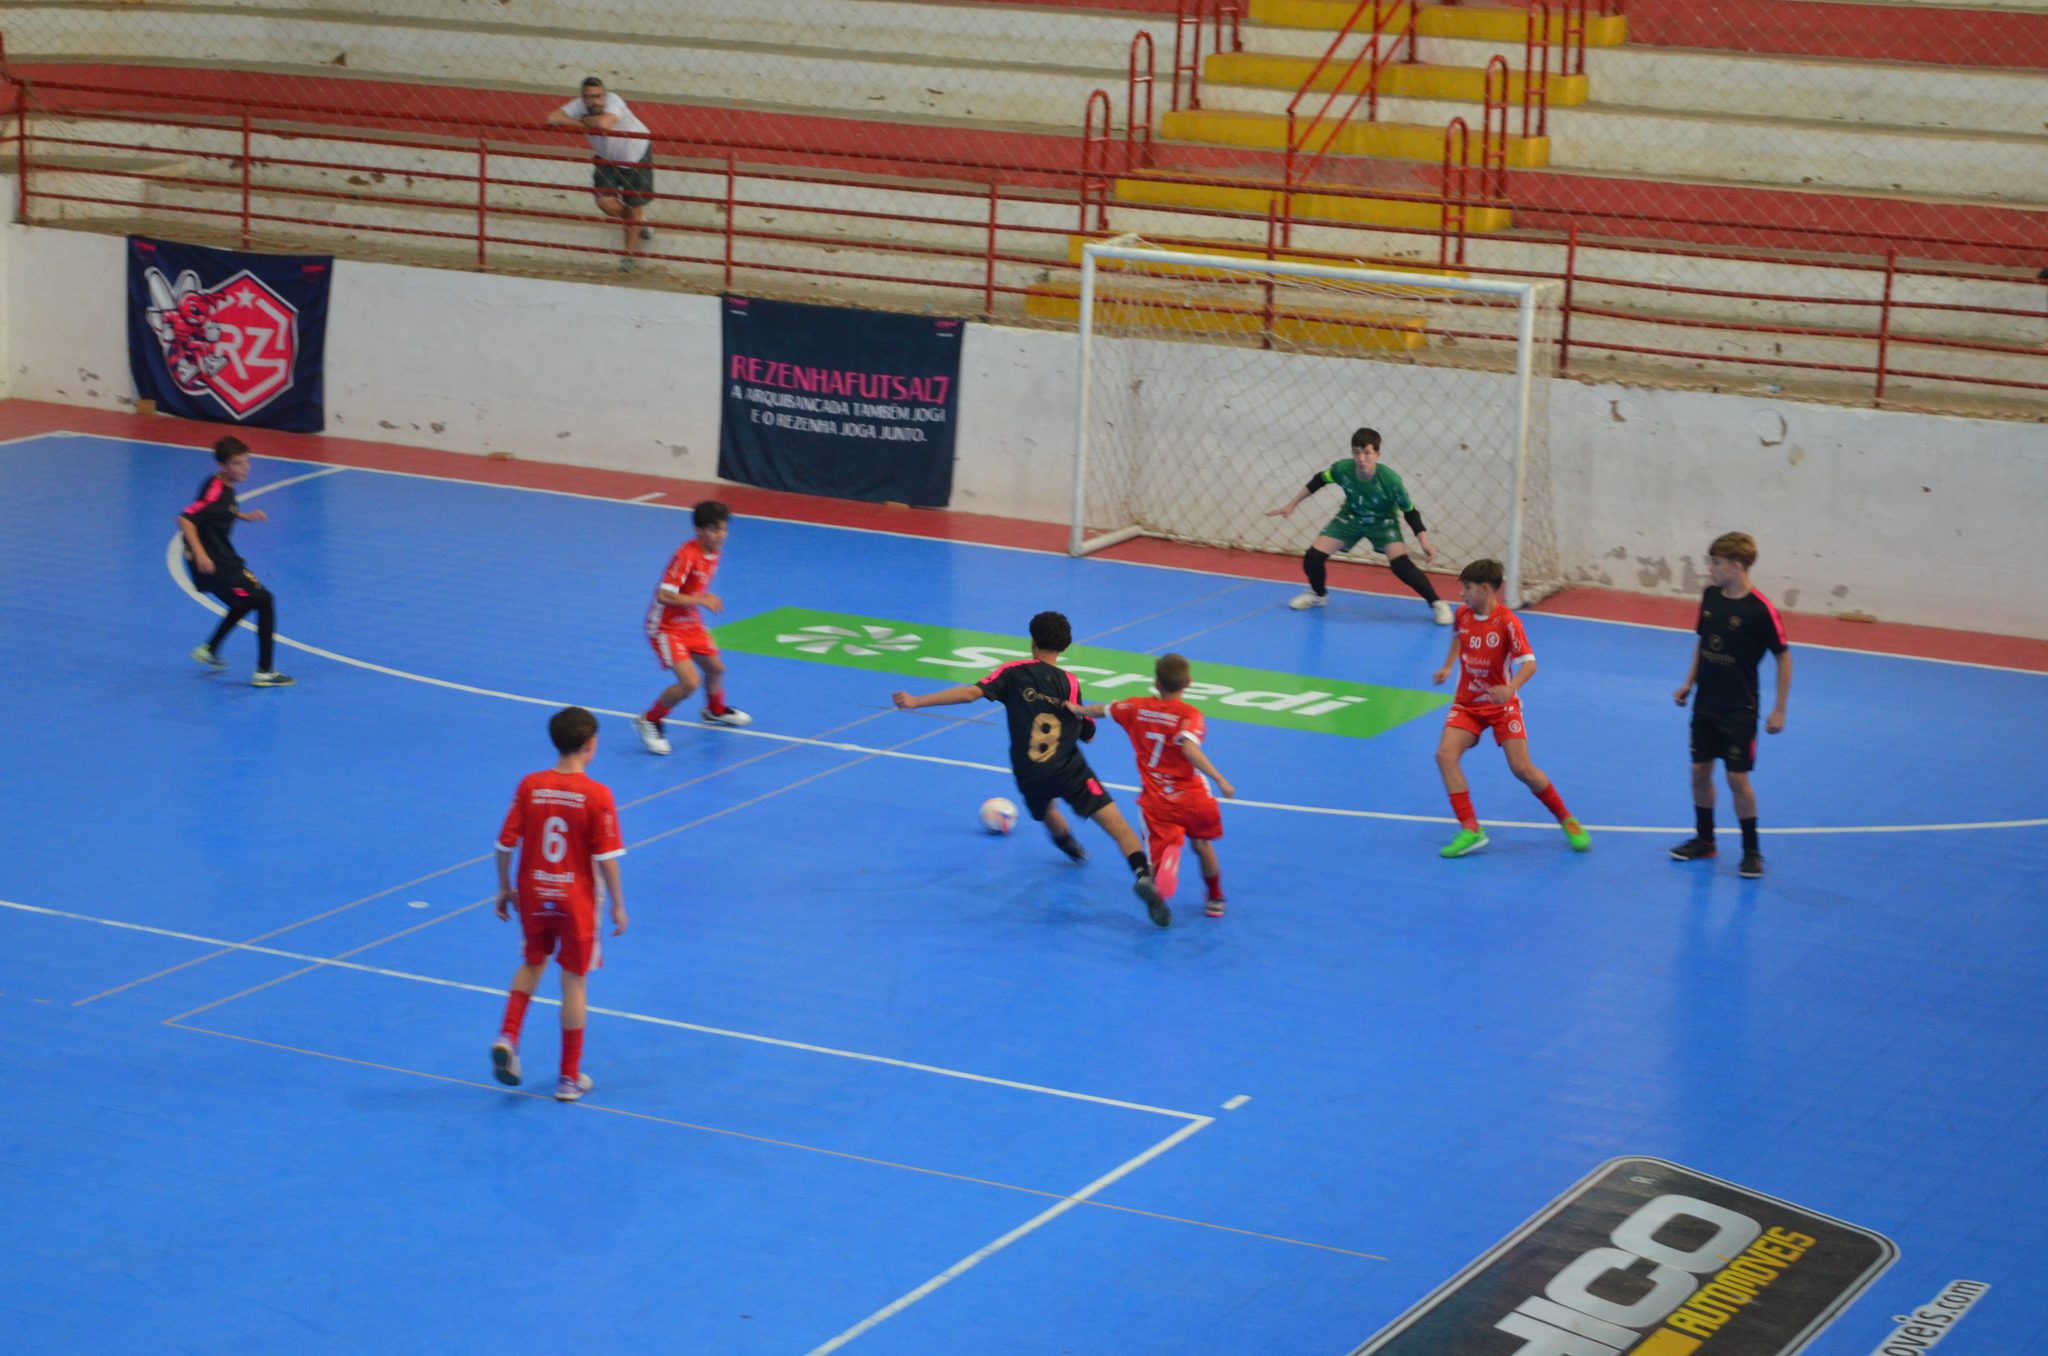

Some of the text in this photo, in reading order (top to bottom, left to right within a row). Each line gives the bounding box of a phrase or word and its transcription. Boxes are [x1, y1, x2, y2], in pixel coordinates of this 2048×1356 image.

[215, 322, 282, 379] RZ
[731, 384, 743, 400] A
[750, 408, 760, 423] E
[761, 410, 775, 425] O
[776, 413, 837, 434] REZENHA
[839, 422, 876, 438] JOGA
[1469, 635, 1482, 649] 50
[915, 646, 1369, 716] Scredi
[1028, 712, 1062, 763] 8
[1144, 731, 1166, 768] 7
[541, 815, 569, 863] 6
